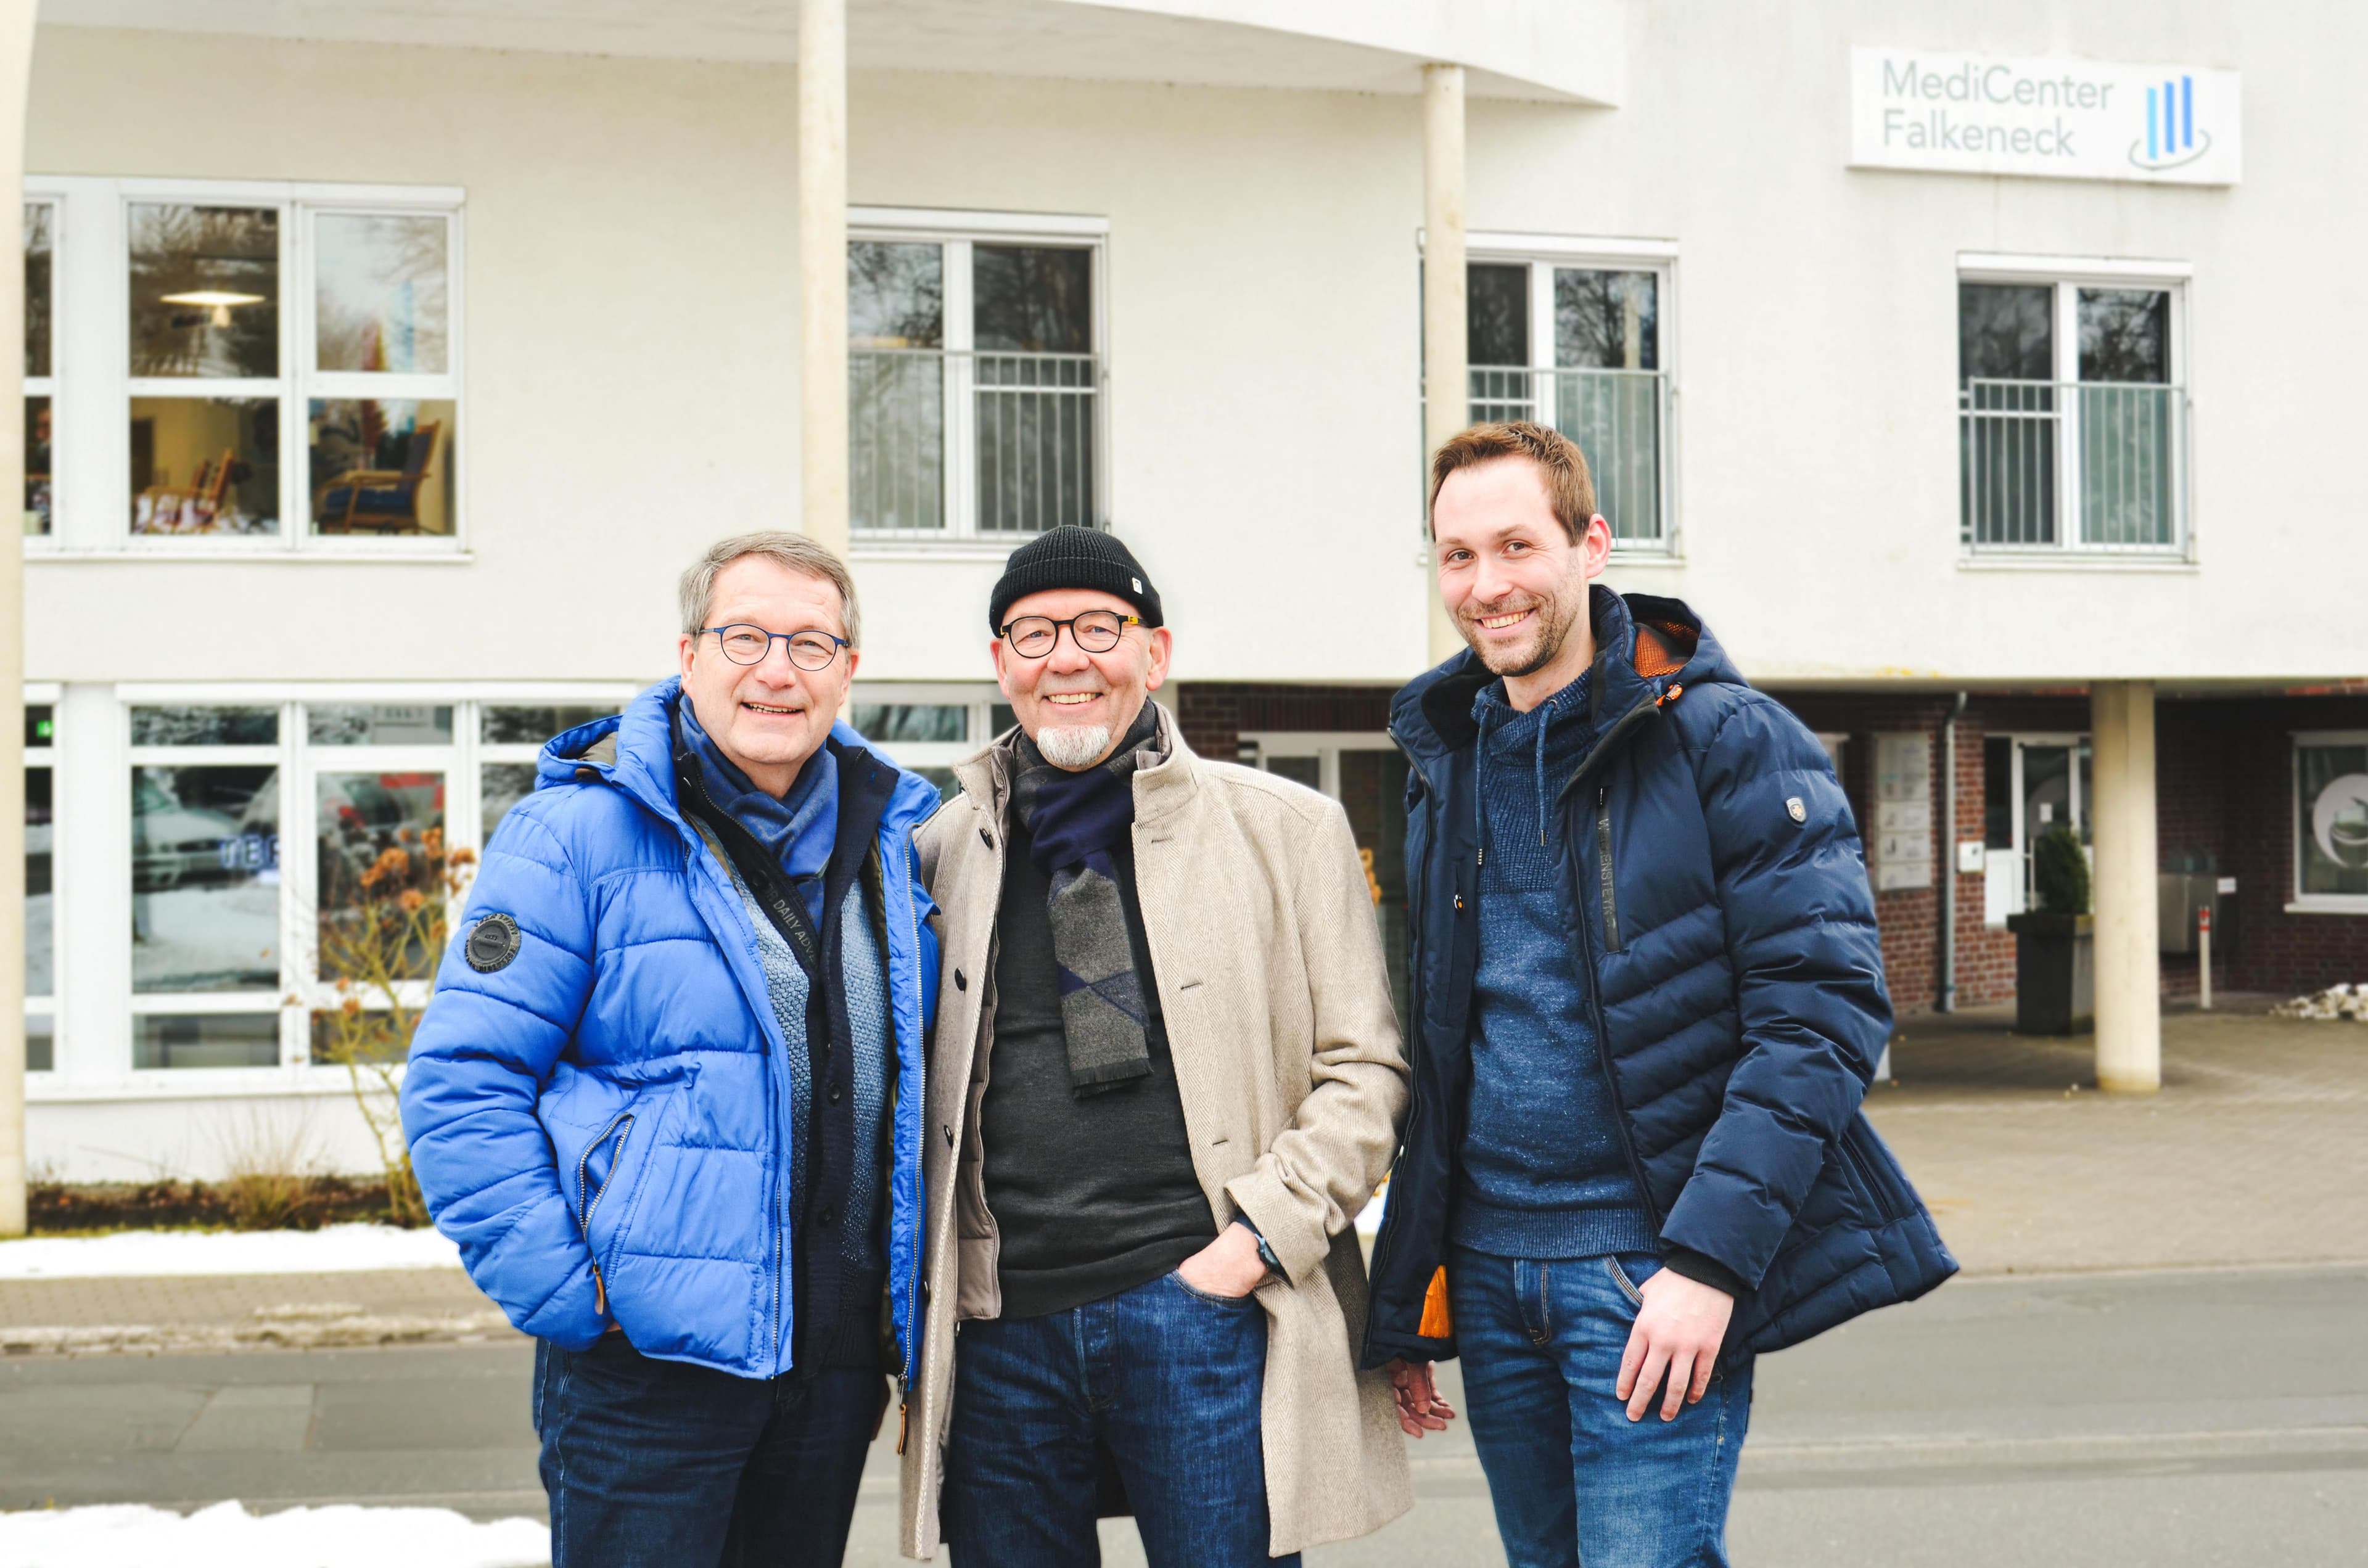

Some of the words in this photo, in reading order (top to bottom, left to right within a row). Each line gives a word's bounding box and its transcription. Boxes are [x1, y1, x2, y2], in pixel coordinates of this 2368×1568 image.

[1883, 58, 2115, 110] MediCenter
[1883, 108, 2076, 157] Falkeneck
[773, 899, 801, 929] DAILY
